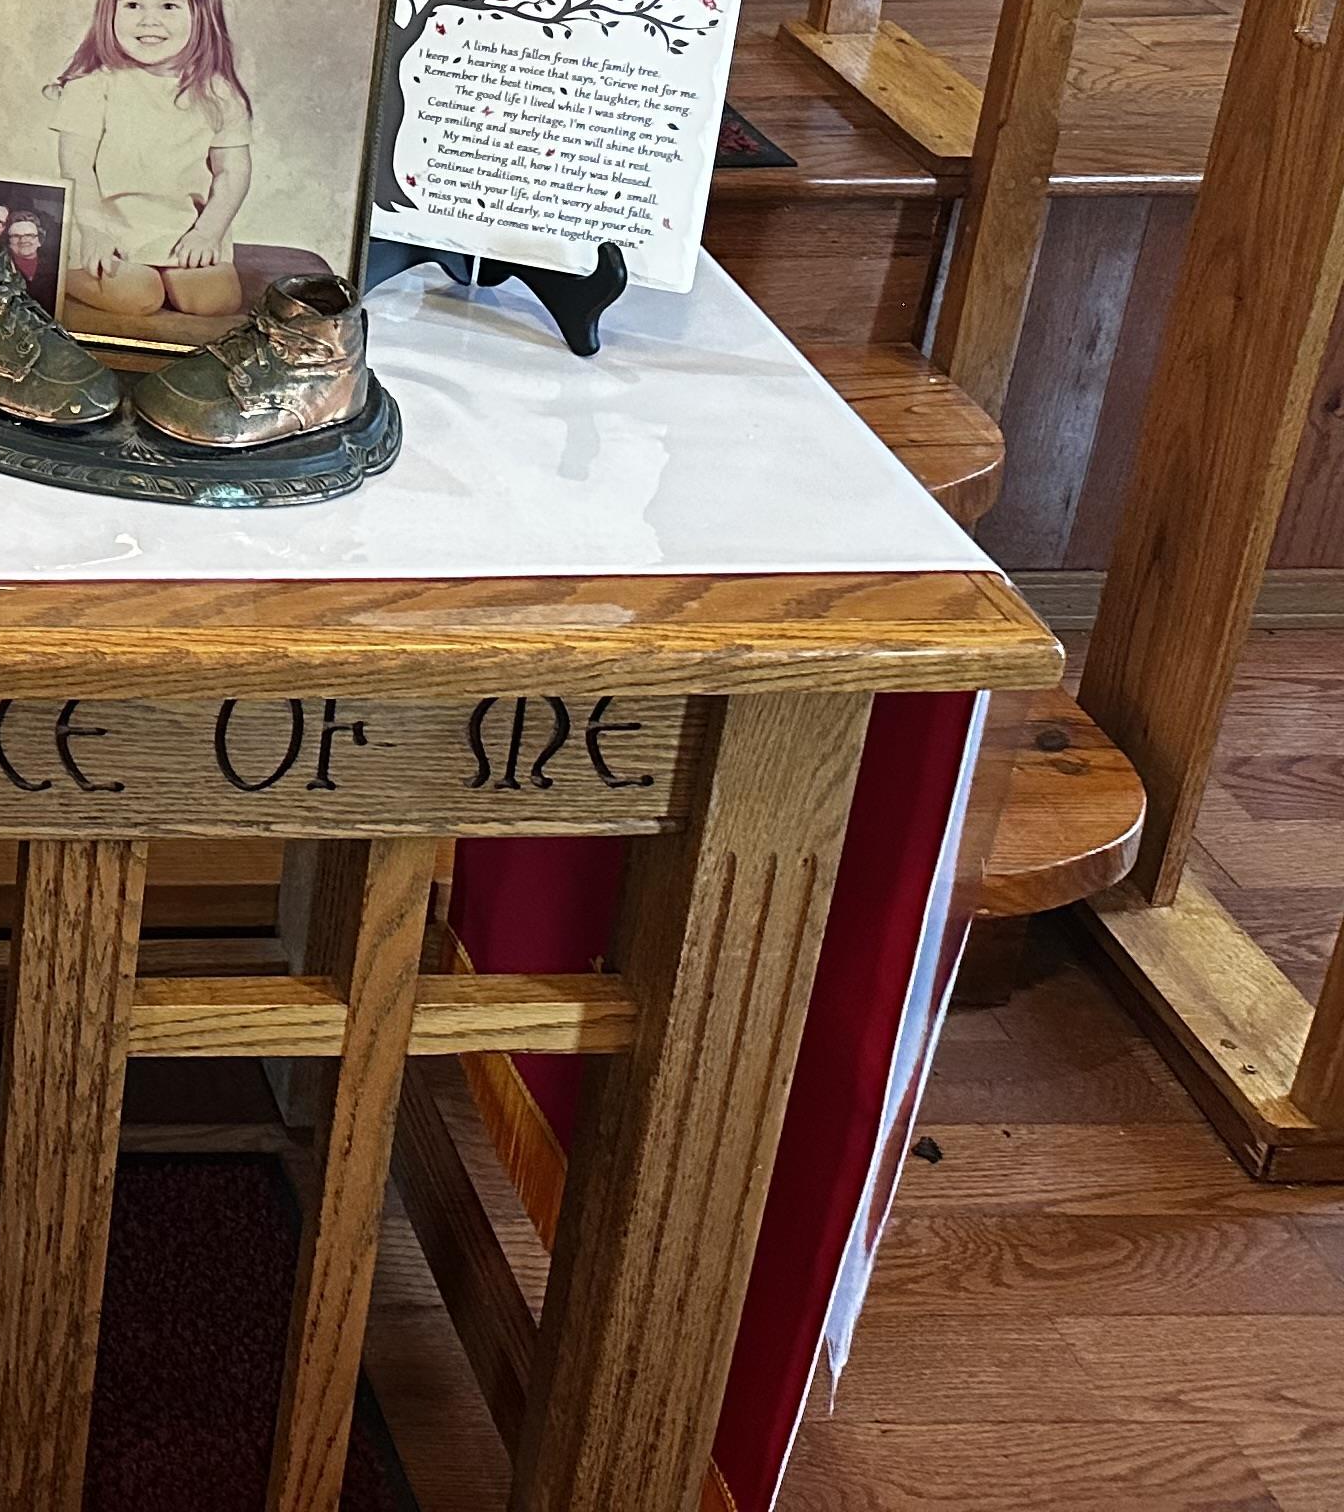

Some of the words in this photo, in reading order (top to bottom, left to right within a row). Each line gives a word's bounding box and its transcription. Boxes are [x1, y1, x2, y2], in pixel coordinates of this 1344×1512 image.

[419, 48, 422, 57] I
[425, 48, 448, 64] keep
[467, 54, 507, 73] hearing
[519, 66, 544, 76] voice
[547, 67, 568, 79] that
[641, 84, 658, 93] not
[658, 84, 677, 97] for
[462, 40, 470, 49] A
[474, 40, 497, 53] limb
[500, 44, 518, 56] has
[519, 47, 551, 64] fallen
[551, 52, 578, 65] from
[582, 56, 598, 68] the
[598, 59, 634, 76] family
[424, 64, 478, 81] Remember
[481, 73, 497, 84] the
[500, 75, 520, 88] best
[574, 87, 590, 98] the
[644, 98, 660, 109] the
[455, 85, 473, 96] The
[475, 90, 502, 101] good
[504, 91, 520, 105] life
[524, 95, 527, 104] I
[530, 95, 554, 109] lived
[558, 101, 584, 113] while
[588, 106, 592, 114] I
[595, 110, 613, 118] was
[418, 110, 442, 124] Keep
[444, 116, 483, 132] smiling
[486, 122, 506, 132] and
[509, 127, 540, 140] surely
[542, 130, 559, 141] the
[562, 136, 581, 144] sun
[584, 137, 603, 148] will
[606, 140, 634, 153] shine
[427, 96, 475, 112] Continue
[503, 111, 518, 121] my
[570, 118, 585, 129] I'm
[588, 125, 636, 140] counting
[438, 144, 508, 167] Remembering
[530, 158, 551, 171] how
[554, 163, 558, 172] I
[561, 165, 586, 179] truly
[589, 172, 608, 180] was
[443, 129, 459, 143] My
[462, 135, 490, 145] mind
[492, 138, 500, 147] is
[503, 141, 513, 149] at
[560, 151, 576, 162] my
[578, 153, 600, 163] soul
[614, 159, 624, 167] at
[427, 158, 473, 174] Continue
[534, 178, 546, 186] no
[550, 181, 584, 191] matter
[586, 184, 608, 196] how
[427, 173, 441, 183] Go
[460, 180, 481, 190] with
[483, 185, 508, 195] your
[532, 190, 558, 204] don't
[561, 198, 591, 211] worry
[594, 201, 624, 215] about
[422, 187, 425, 196] I
[428, 191, 451, 200] miss
[452, 196, 471, 204] you
[490, 199, 503, 209] all
[558, 209, 581, 225] keep
[584, 218, 598, 228] up
[600, 221, 626, 230] your
[428, 204, 454, 216] Until
[457, 208, 473, 220] the
[476, 212, 494, 226] day
[497, 219, 528, 229] comes
[532, 224, 557, 234] we're
[560, 227, 603, 241] together
